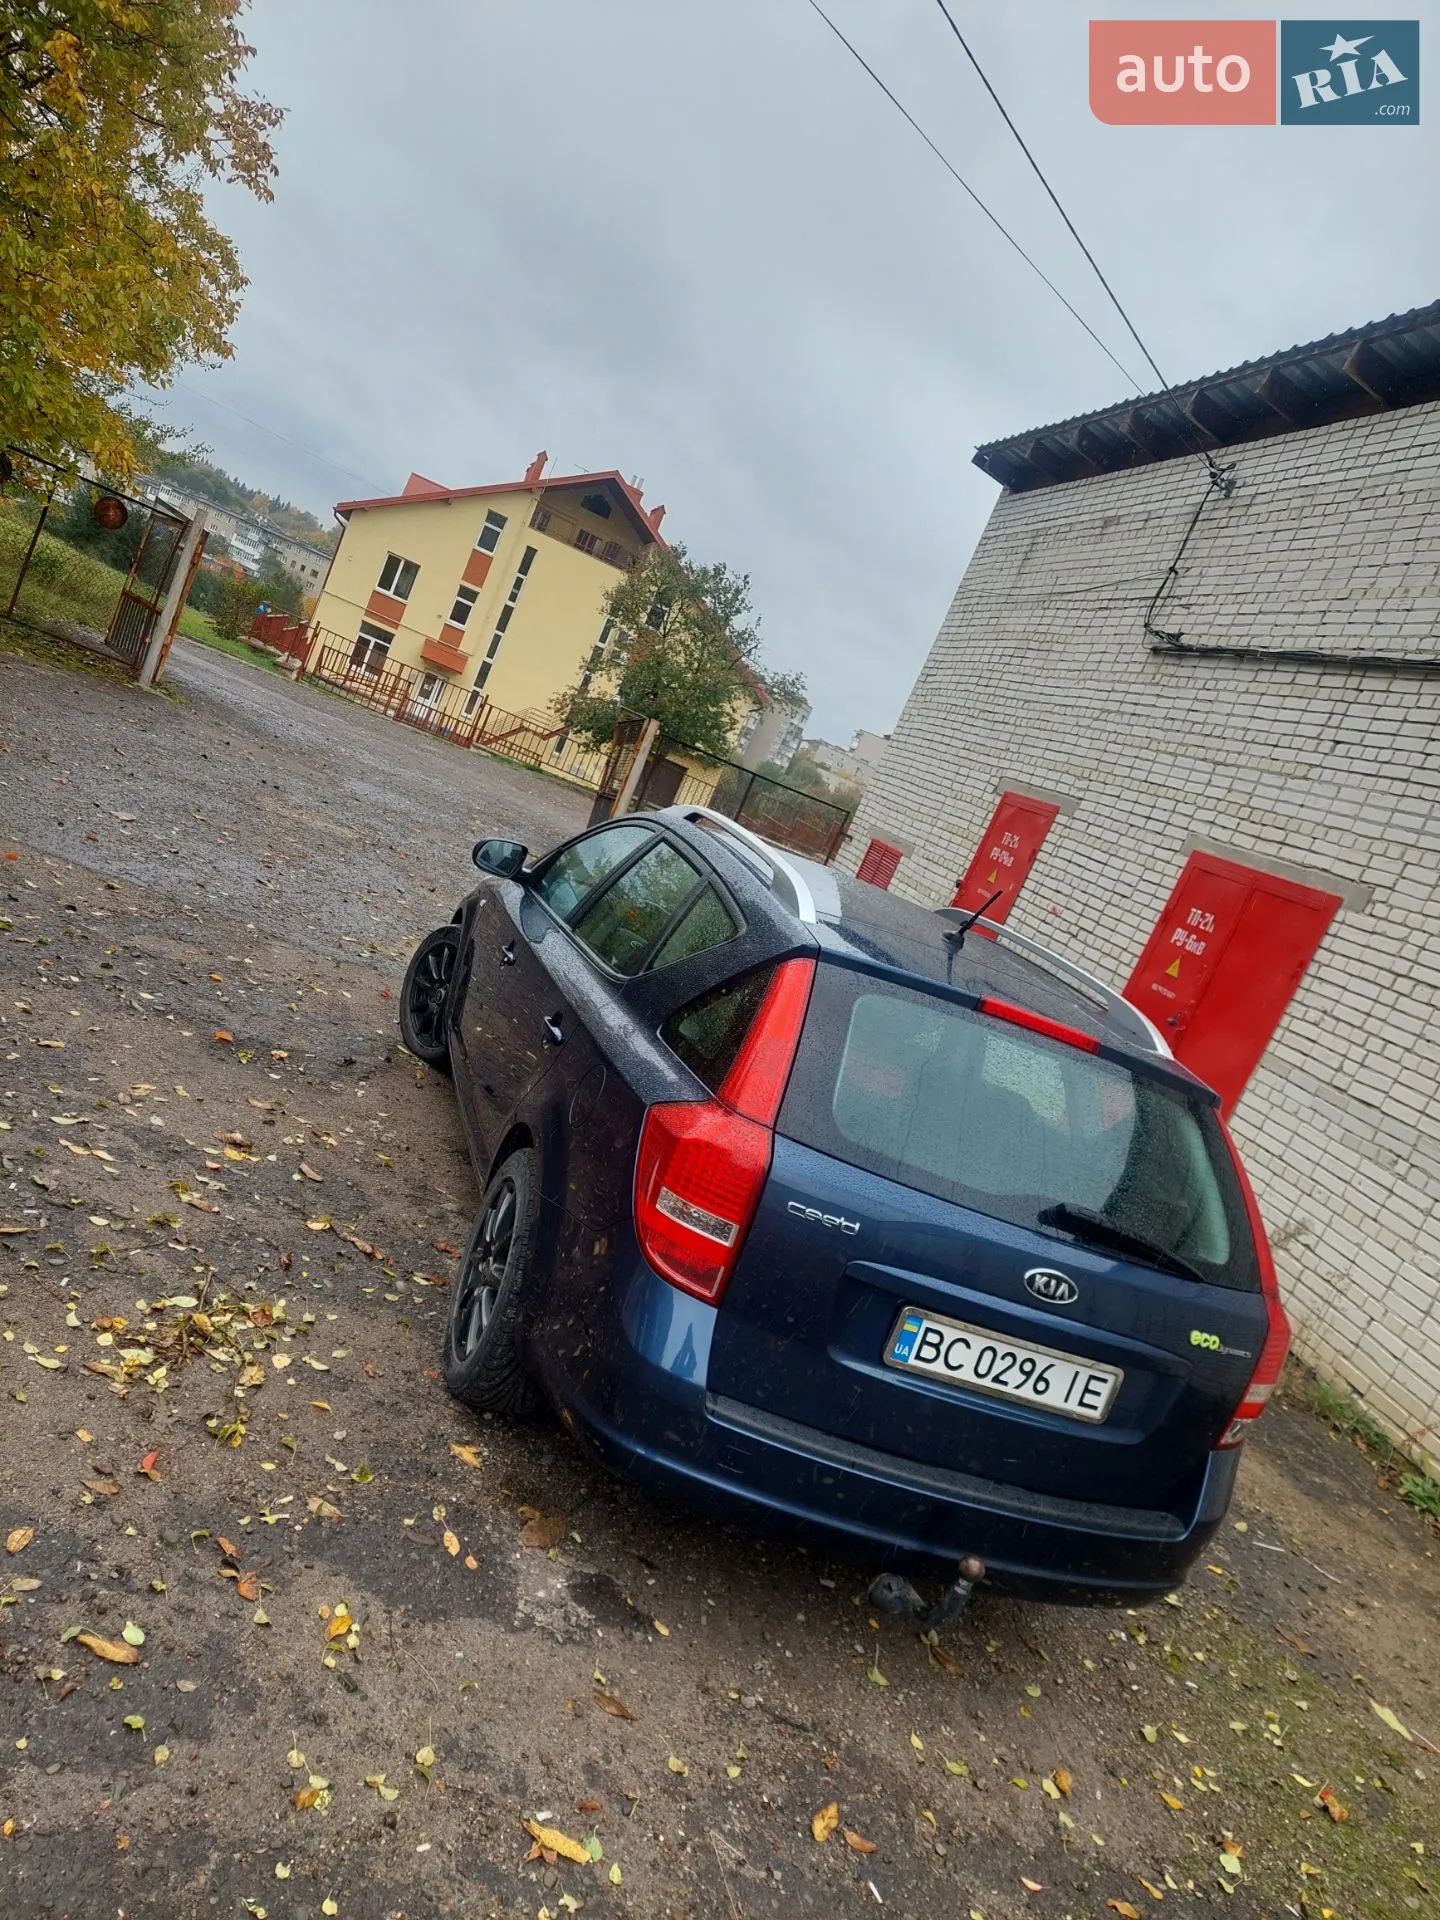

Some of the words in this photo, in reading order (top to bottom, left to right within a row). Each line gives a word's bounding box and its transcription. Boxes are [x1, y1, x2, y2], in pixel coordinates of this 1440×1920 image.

[1032, 1273, 1069, 1301] KIA
[894, 1343, 910, 1356] UA
[1190, 1329, 1220, 1350] eco
[914, 1326, 972, 1372] BC
[973, 1345, 1057, 1396] 0296
[1063, 1370, 1109, 1412] IE
